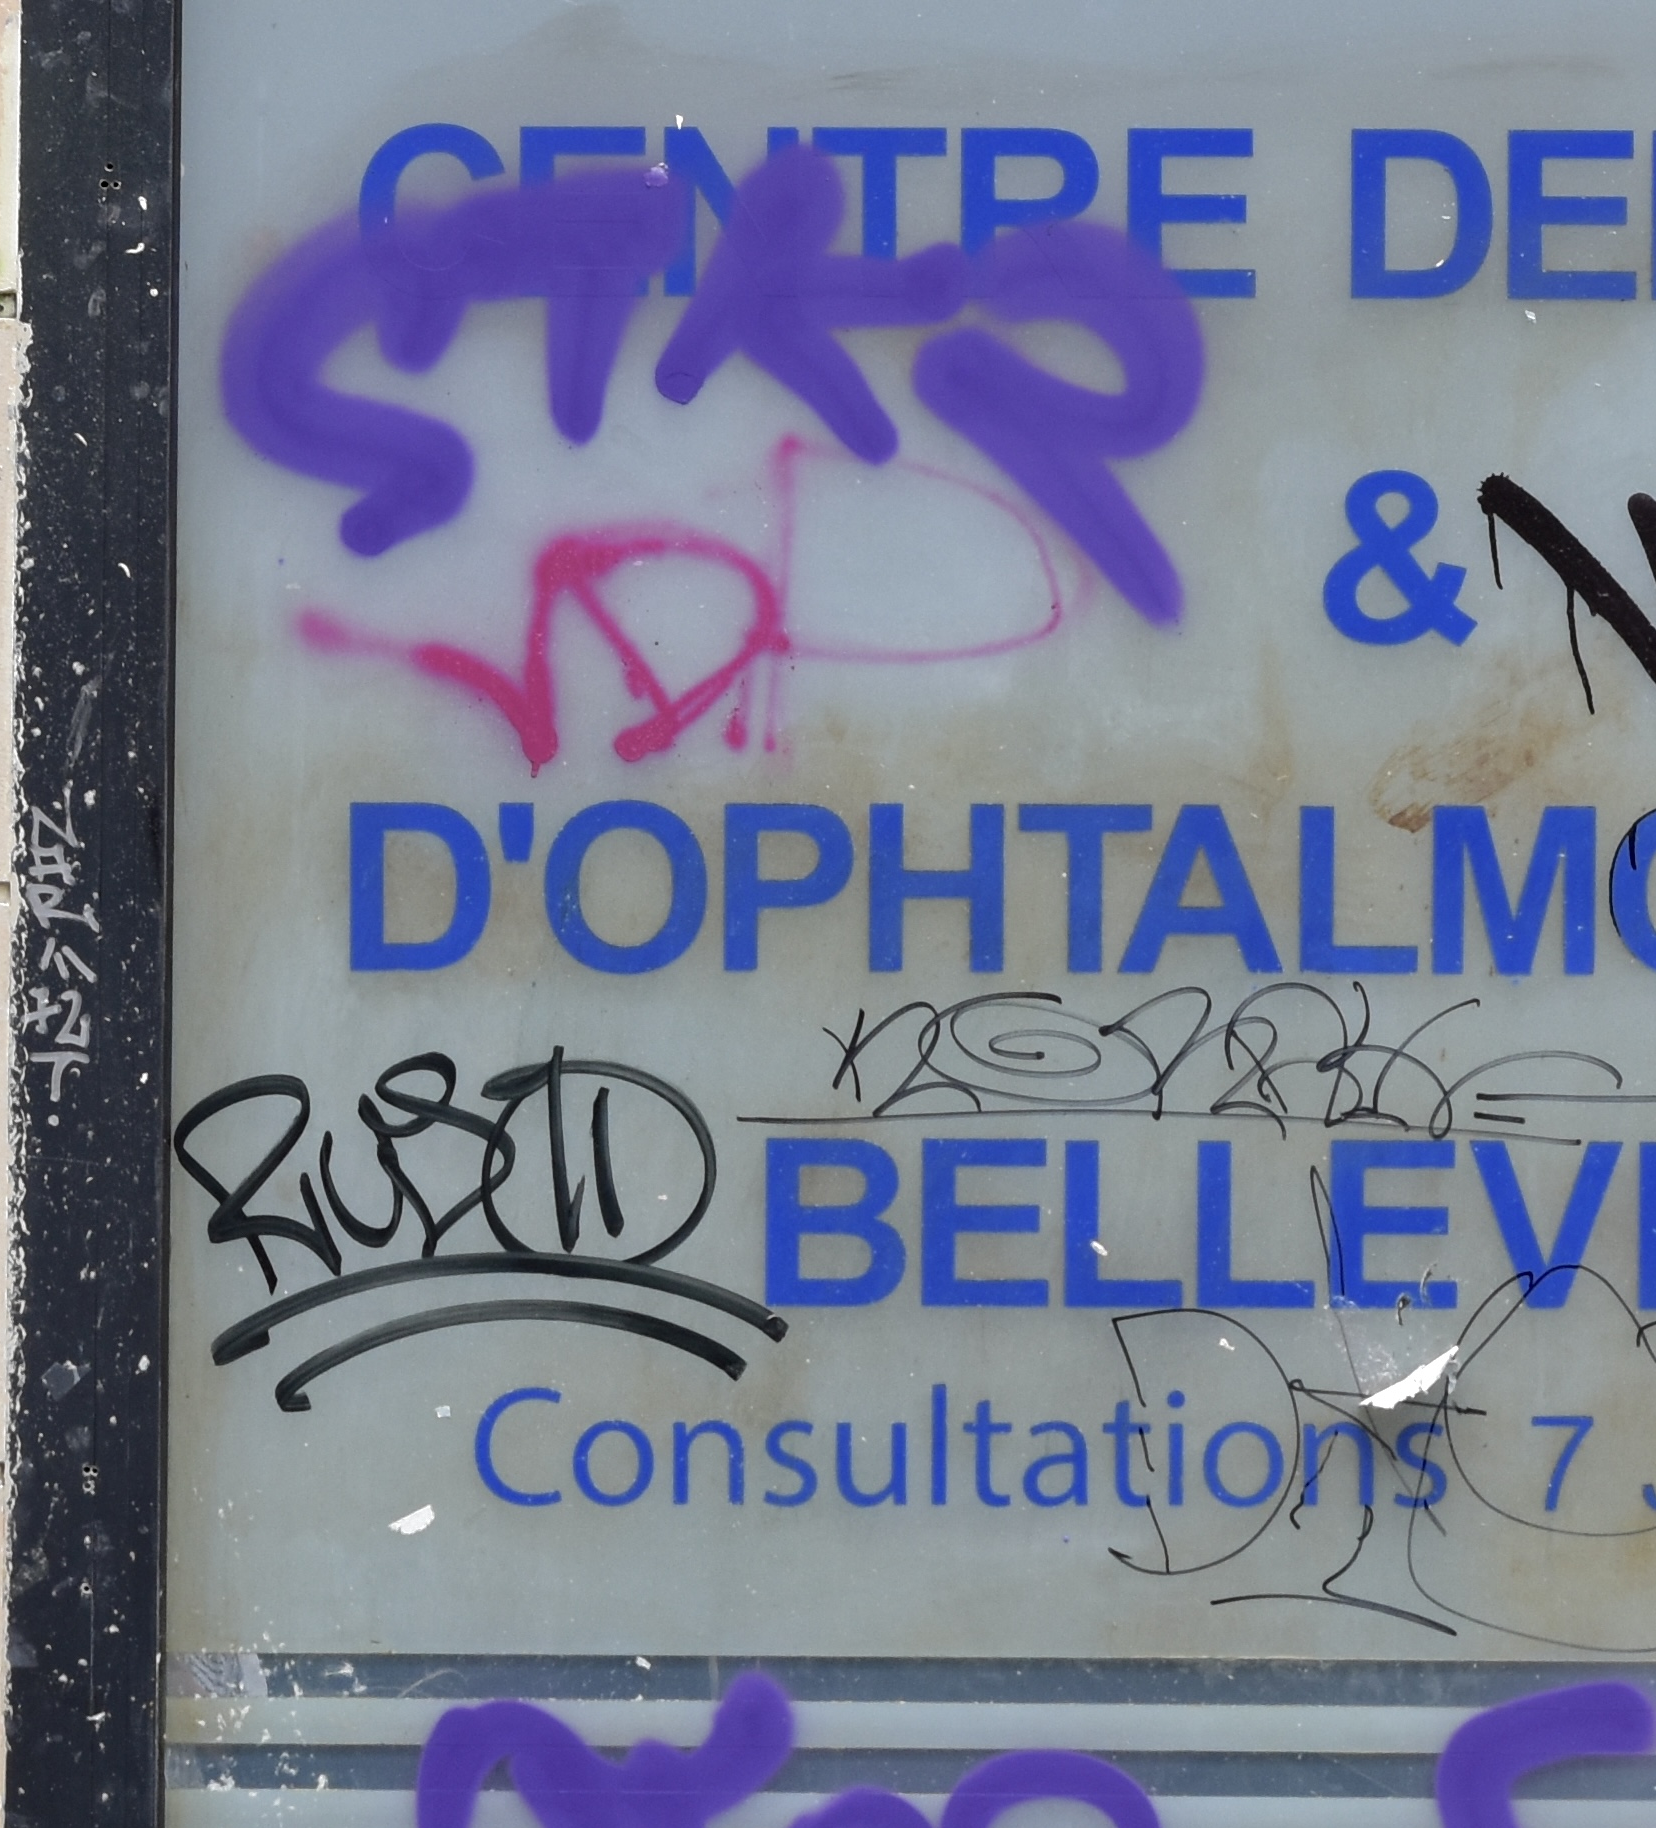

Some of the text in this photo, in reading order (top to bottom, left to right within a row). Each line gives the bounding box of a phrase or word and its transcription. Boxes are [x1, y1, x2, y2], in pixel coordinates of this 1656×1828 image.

[1323, 470, 1477, 646] &
[474, 1384, 1447, 1509] Consultations
[1532, 1415, 1594, 1511] 7
